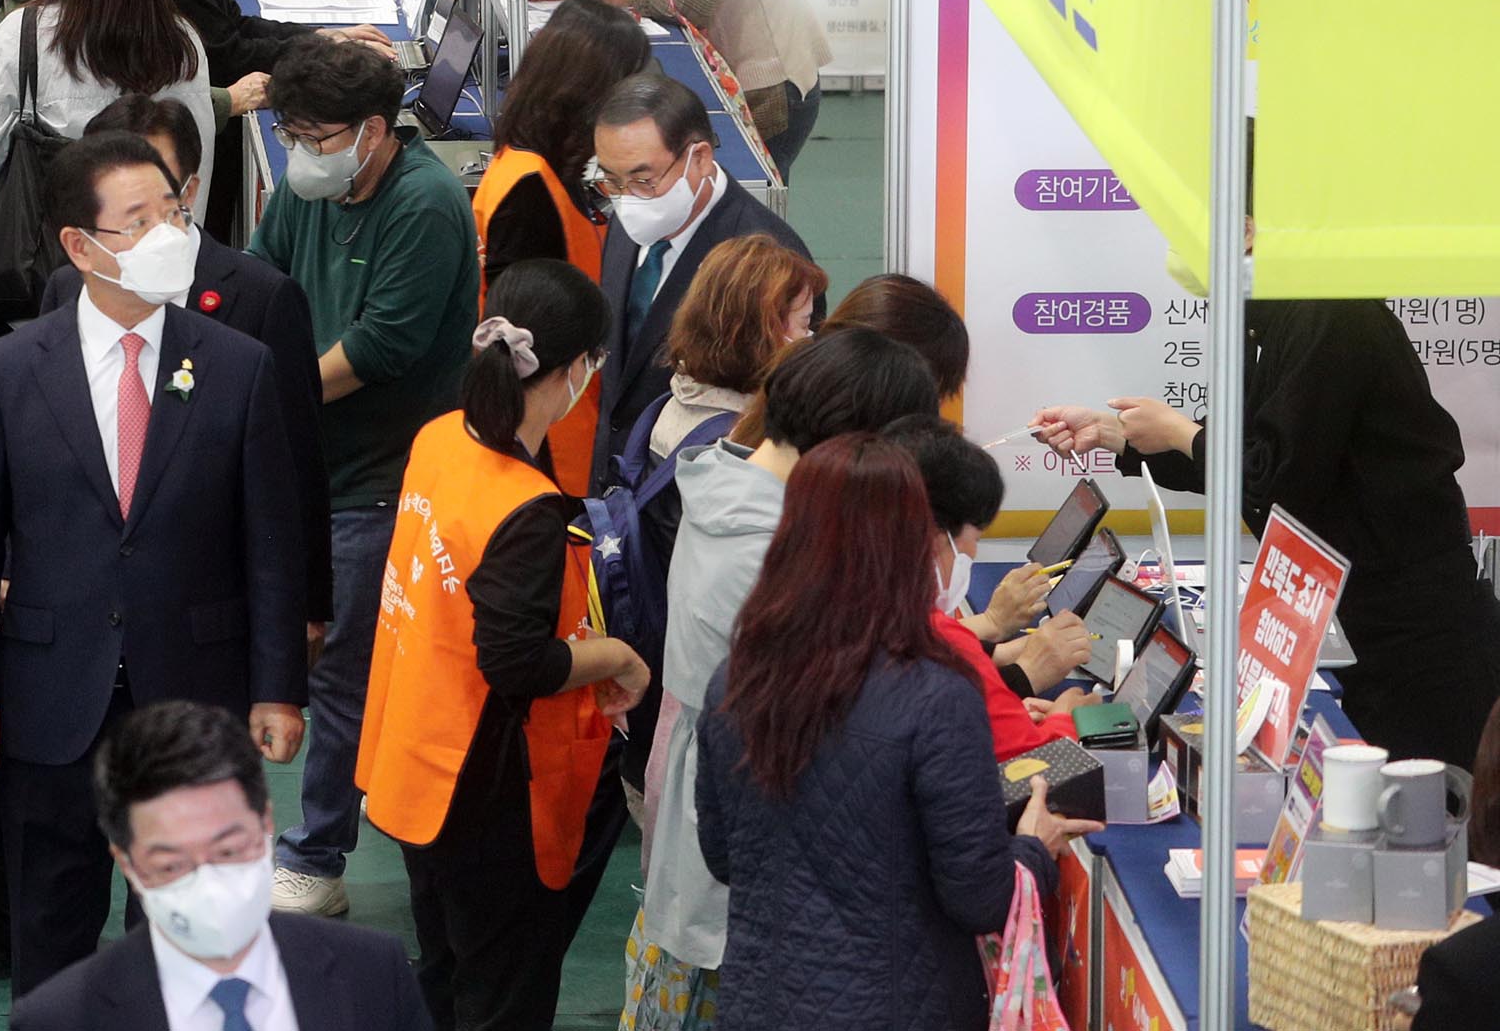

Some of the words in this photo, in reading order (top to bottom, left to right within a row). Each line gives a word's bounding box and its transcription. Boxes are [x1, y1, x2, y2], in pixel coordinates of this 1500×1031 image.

[1034, 175, 1133, 204] 참여기간
[1033, 299, 1131, 328] 참여경품
[1164, 340, 1202, 367] 2등
[1043, 451, 1117, 476] 이벤트
[1259, 544, 1302, 606] 만족도
[1294, 572, 1326, 625] 조사
[1254, 607, 1298, 666] 참여하고
